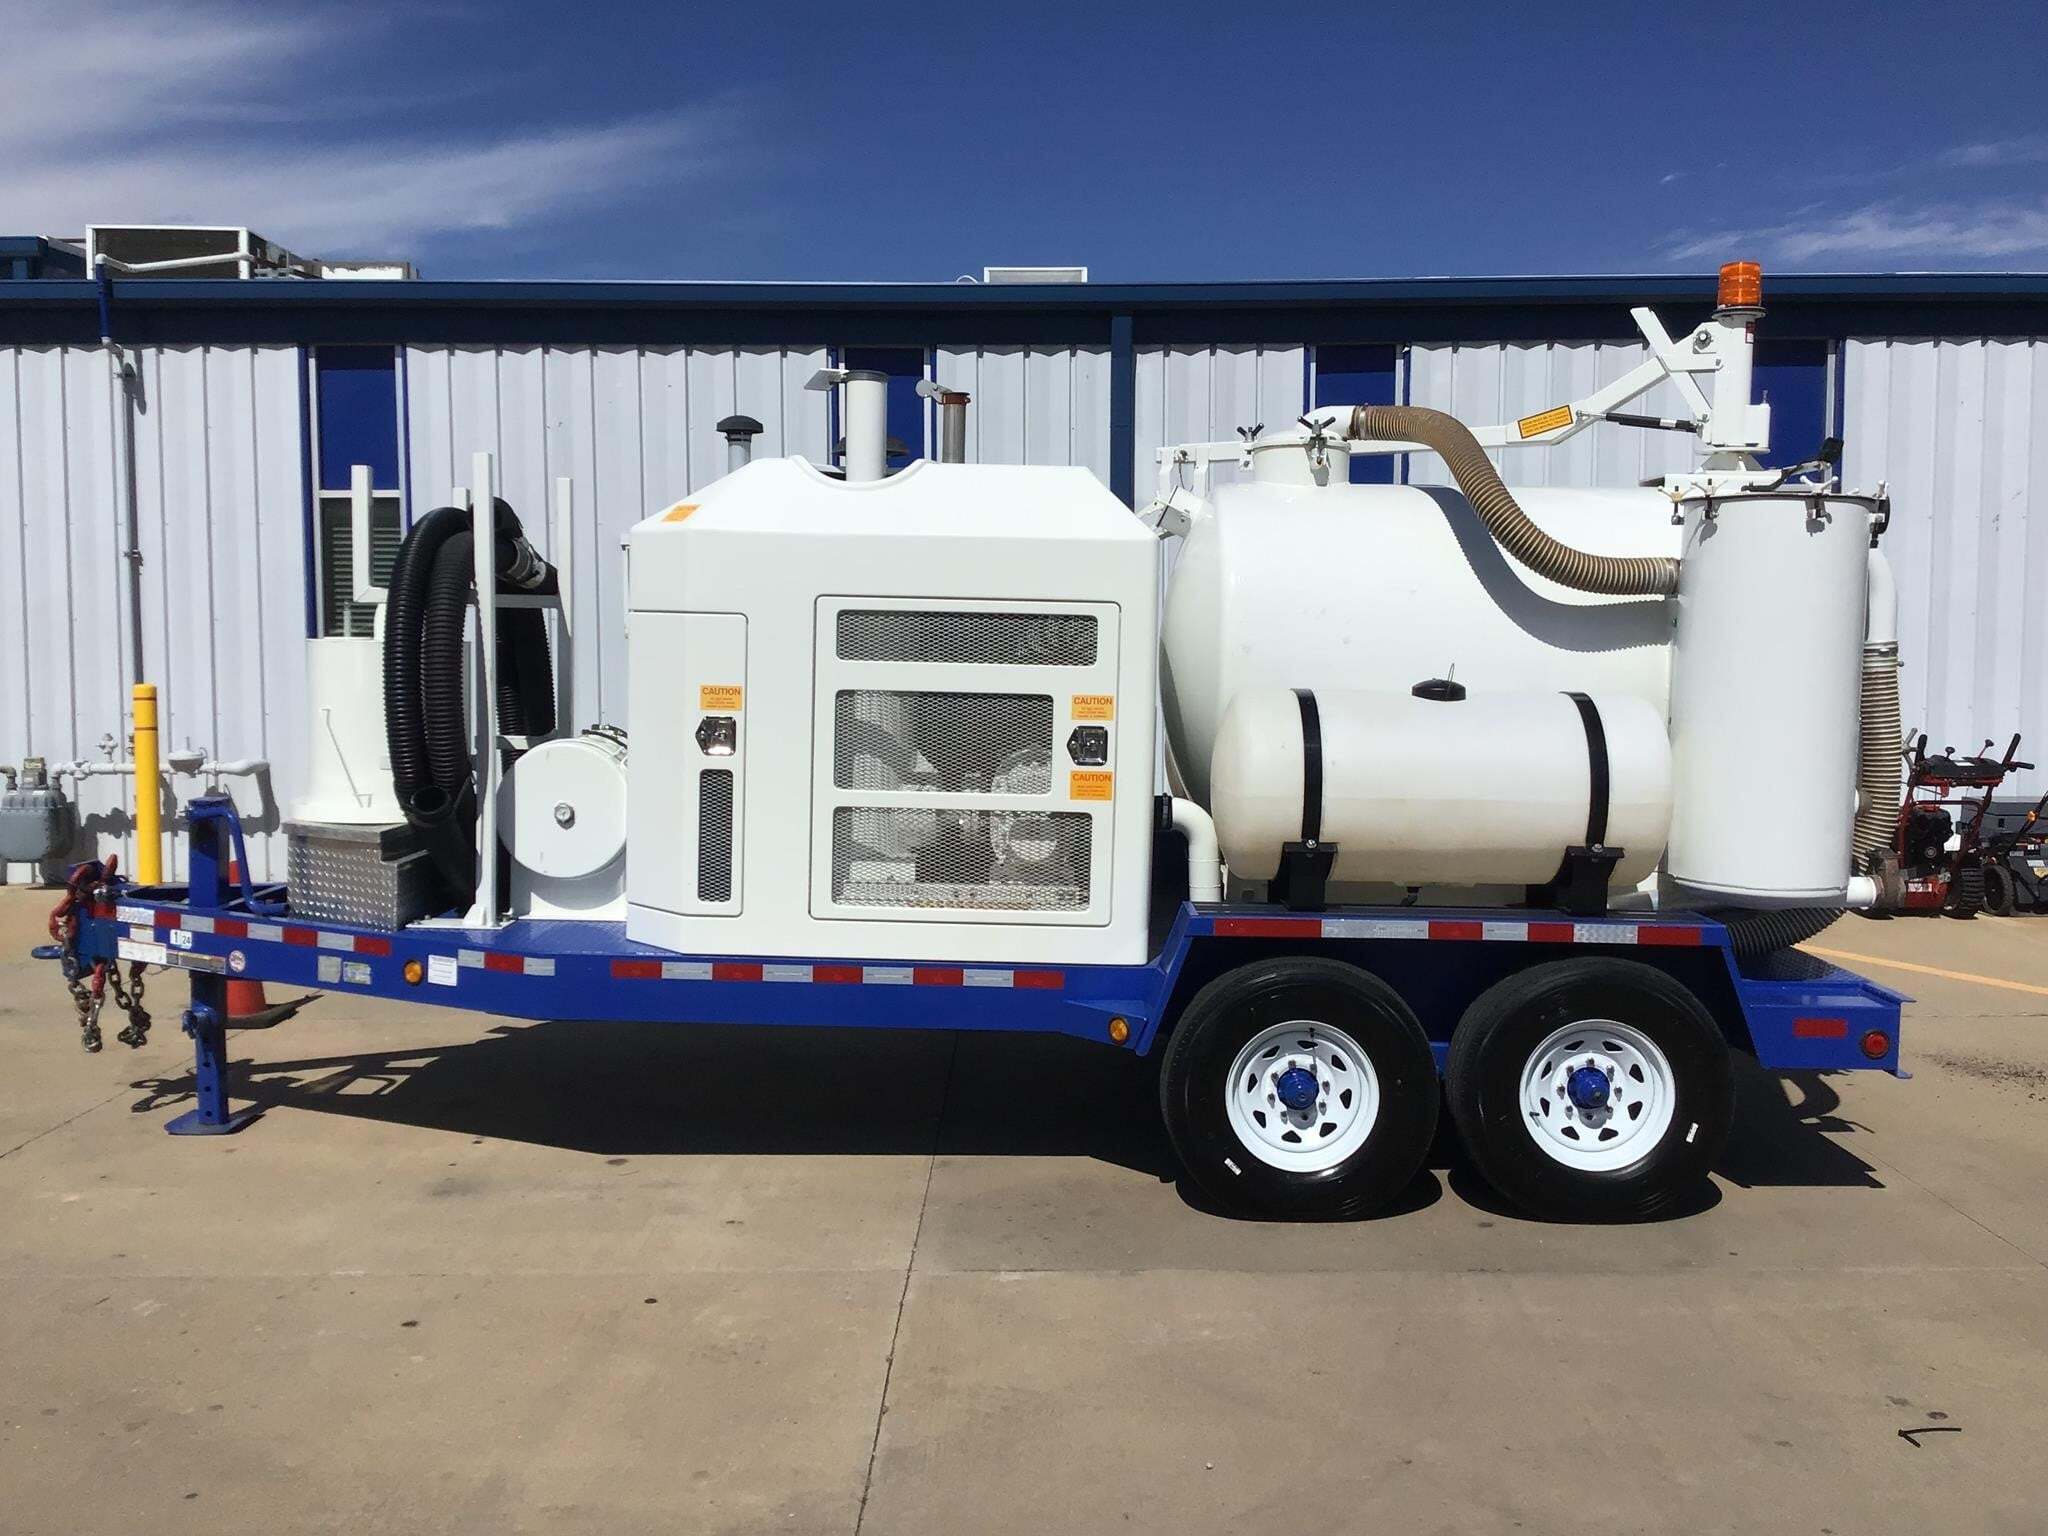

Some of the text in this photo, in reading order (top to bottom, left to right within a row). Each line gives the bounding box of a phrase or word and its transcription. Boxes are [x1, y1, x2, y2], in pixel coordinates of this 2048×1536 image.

[702, 687, 741, 696] CAUTION
[1073, 697, 1112, 706] CAUTION
[1072, 773, 1112, 782] CAUTION
